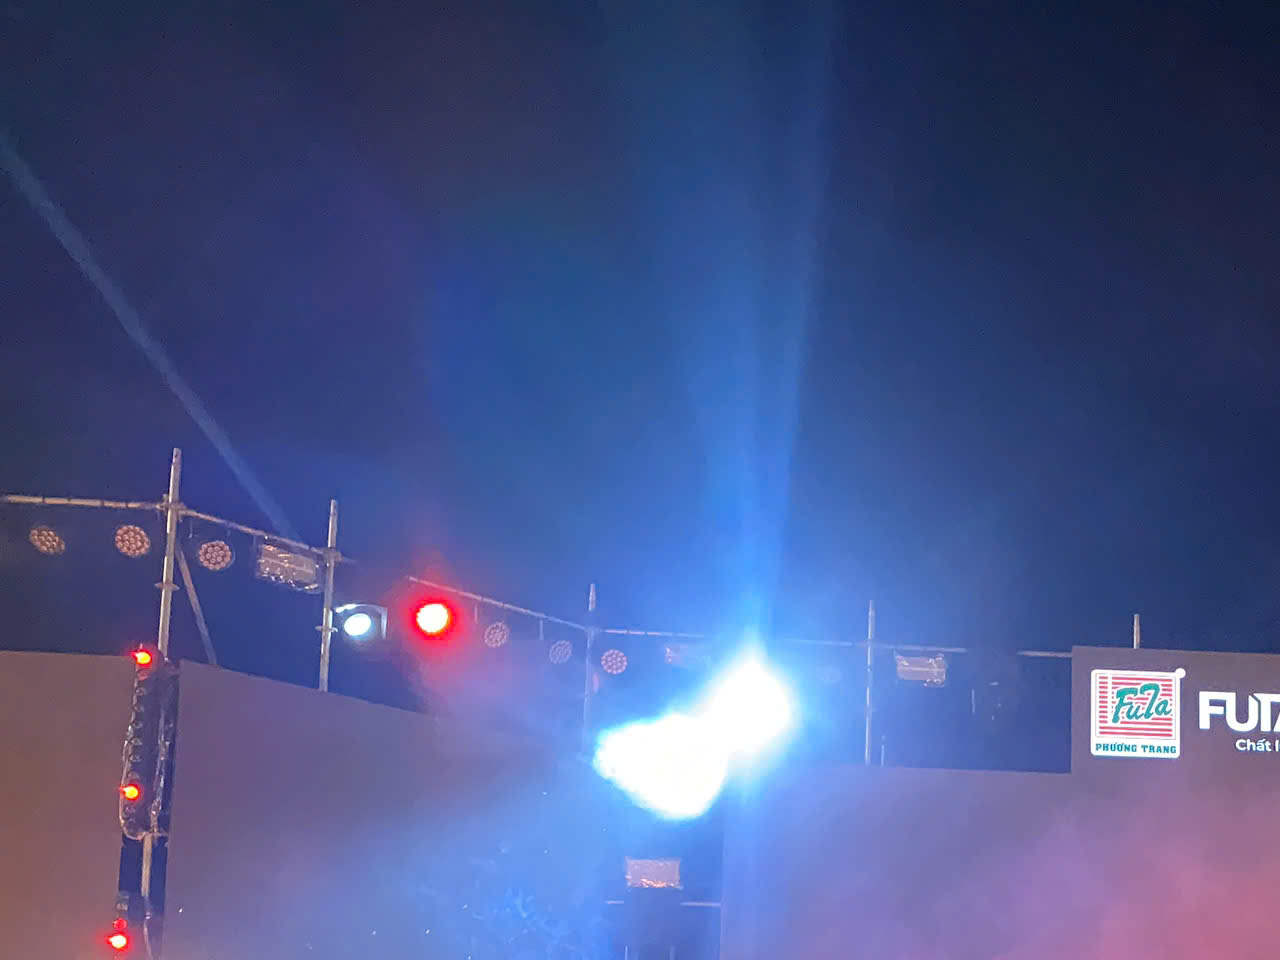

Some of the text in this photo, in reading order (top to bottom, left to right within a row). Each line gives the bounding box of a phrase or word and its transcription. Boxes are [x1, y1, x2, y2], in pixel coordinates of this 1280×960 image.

[1095, 741, 1177, 754] PHƯƠNG TRANG
[1235, 738, 1272, 752] Chất
